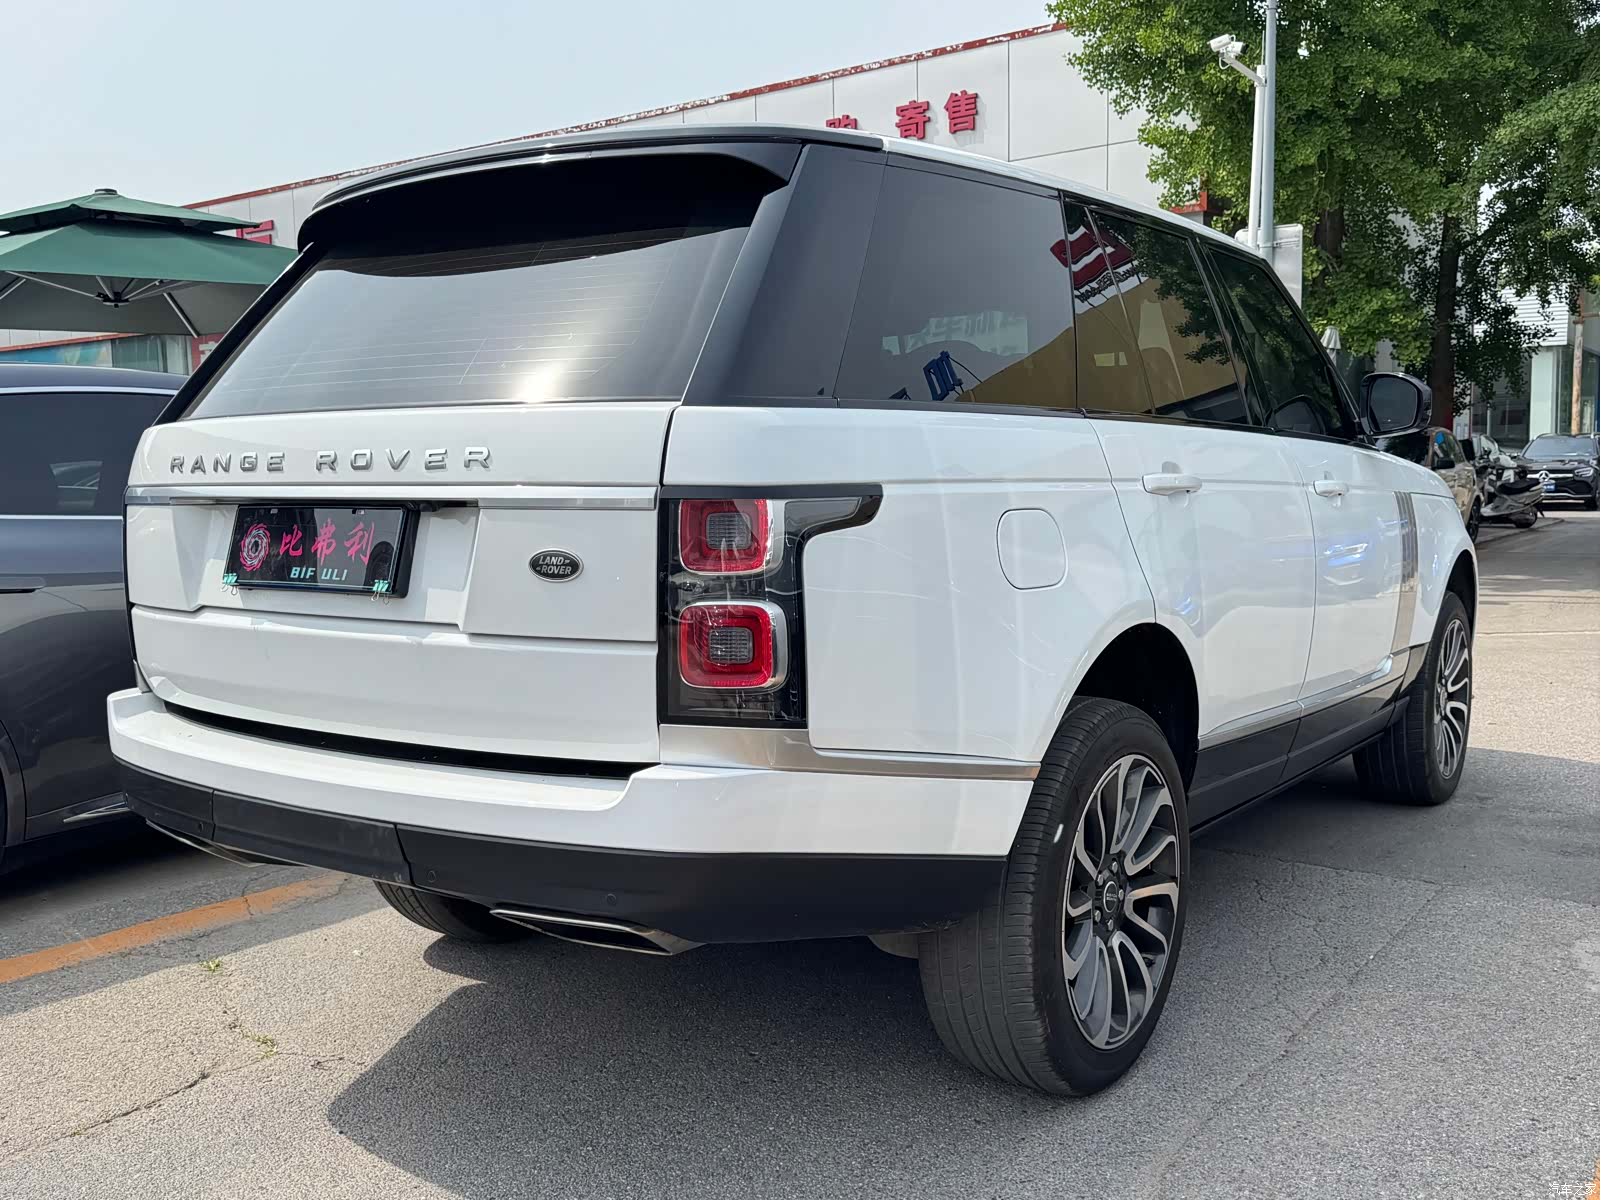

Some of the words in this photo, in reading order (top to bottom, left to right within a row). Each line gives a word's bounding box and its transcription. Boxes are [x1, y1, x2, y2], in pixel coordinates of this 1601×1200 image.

[895, 89, 979, 140] 寄售
[169, 451, 286, 475] RANGE
[315, 446, 492, 473] ROVER
[280, 518, 375, 567] 比弗利
[539, 556, 565, 566] LAND
[541, 565, 573, 575] ROVER
